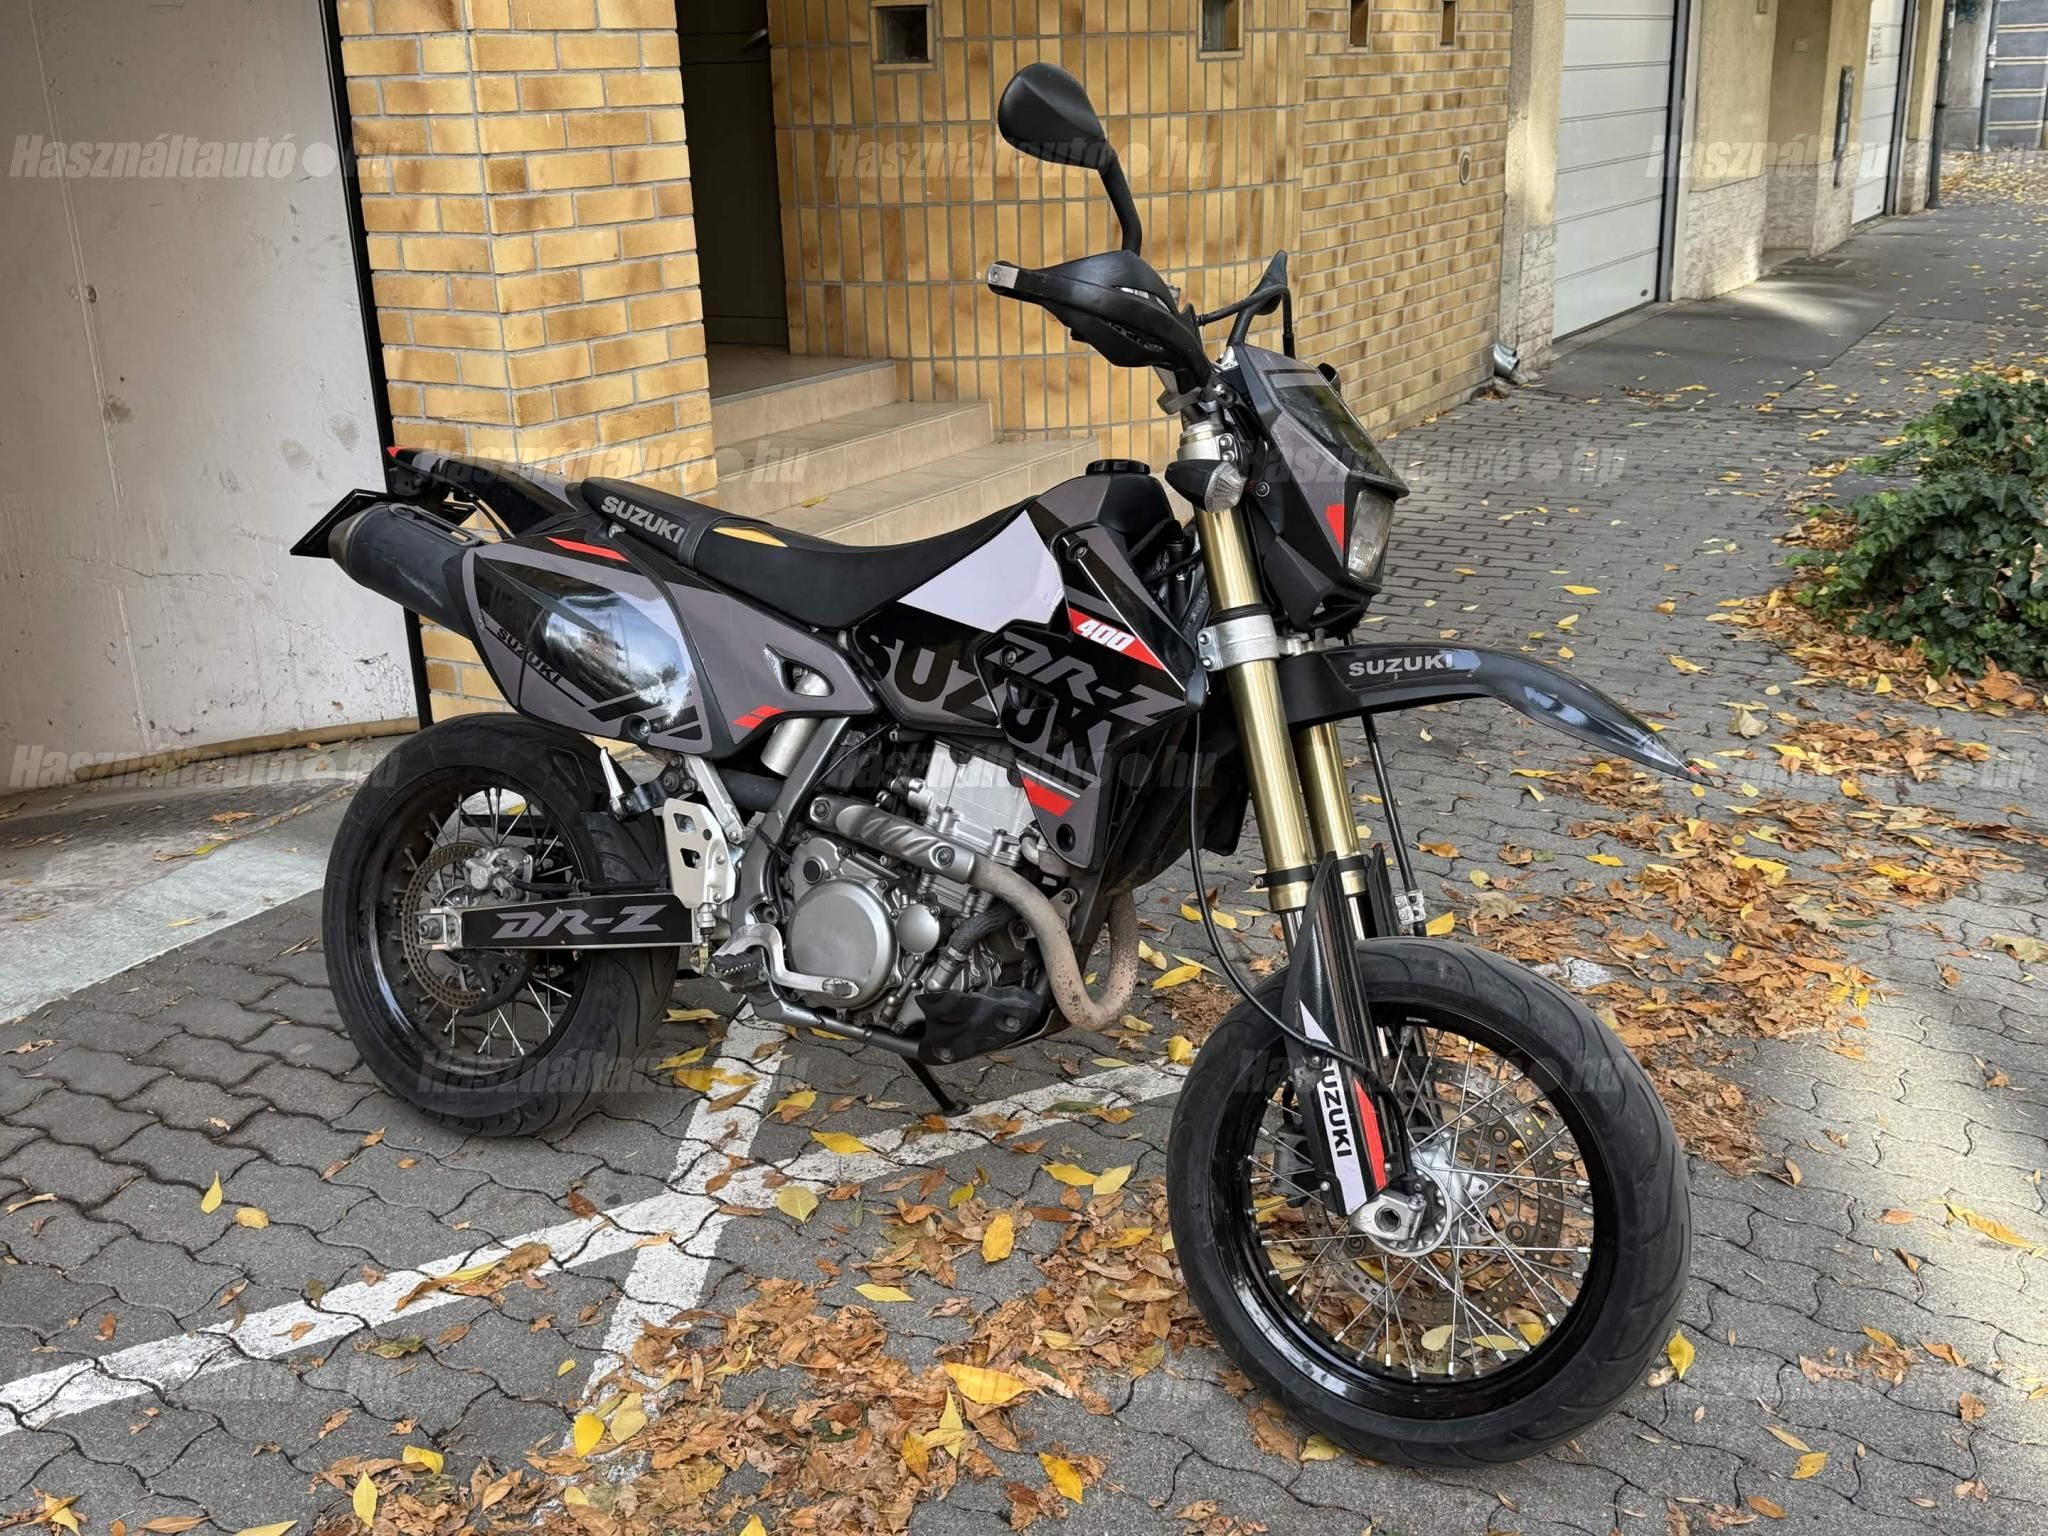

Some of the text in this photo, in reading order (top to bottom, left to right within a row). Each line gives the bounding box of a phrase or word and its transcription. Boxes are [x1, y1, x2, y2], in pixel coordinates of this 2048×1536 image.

[601, 496, 685, 543] SUZUKI
[497, 627, 562, 683] SUZUKI
[1077, 619, 1136, 652] 400
[985, 630, 1186, 726] DR-Z
[1348, 654, 1453, 677] SUZUKI
[492, 904, 668, 939] DR-Z
